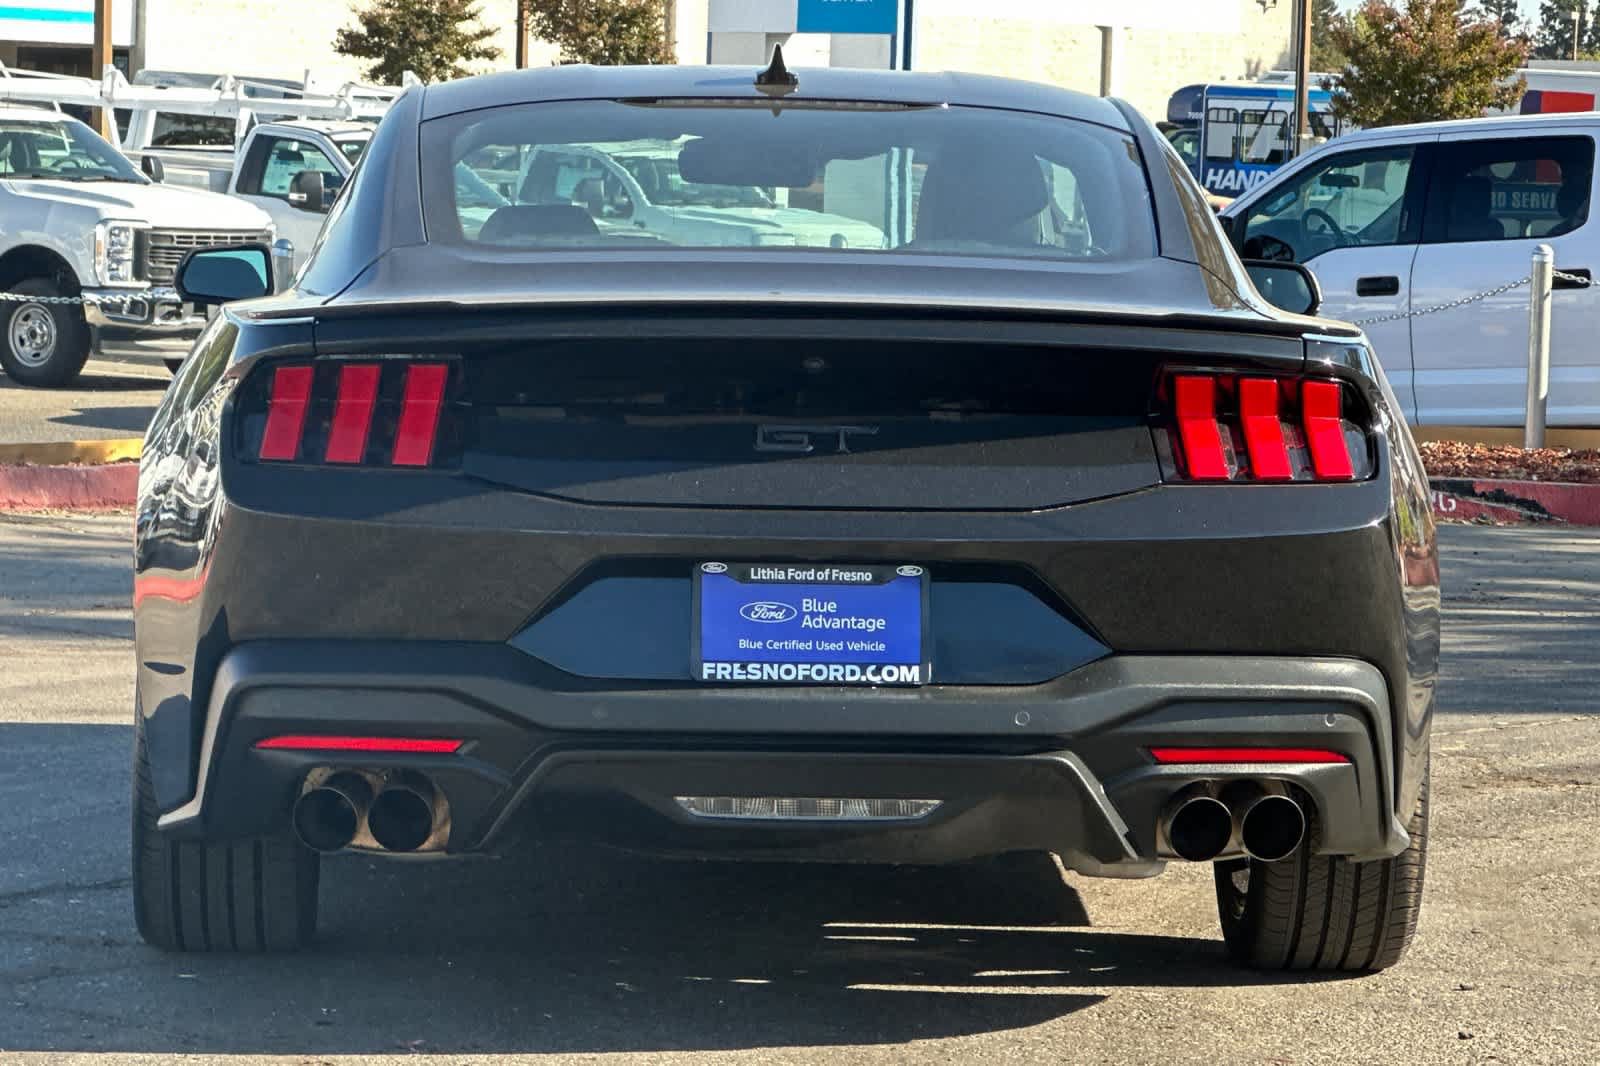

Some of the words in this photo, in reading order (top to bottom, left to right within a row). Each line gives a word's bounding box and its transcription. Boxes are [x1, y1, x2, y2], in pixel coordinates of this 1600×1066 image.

[1205, 168, 1274, 191] HAND
[754, 424, 879, 453] GT
[750, 567, 785, 580] Lithia
[787, 568, 815, 580] Ford
[816, 568, 831, 580] of
[831, 569, 873, 581] Fresno
[802, 598, 837, 613] Blue
[801, 614, 886, 632] Advantage
[738, 639, 763, 649] Blue
[766, 639, 813, 651] Certified
[816, 641, 844, 651] Used
[847, 641, 886, 652] Vehicle
[702, 663, 920, 683] FRESNOFORD.COM
